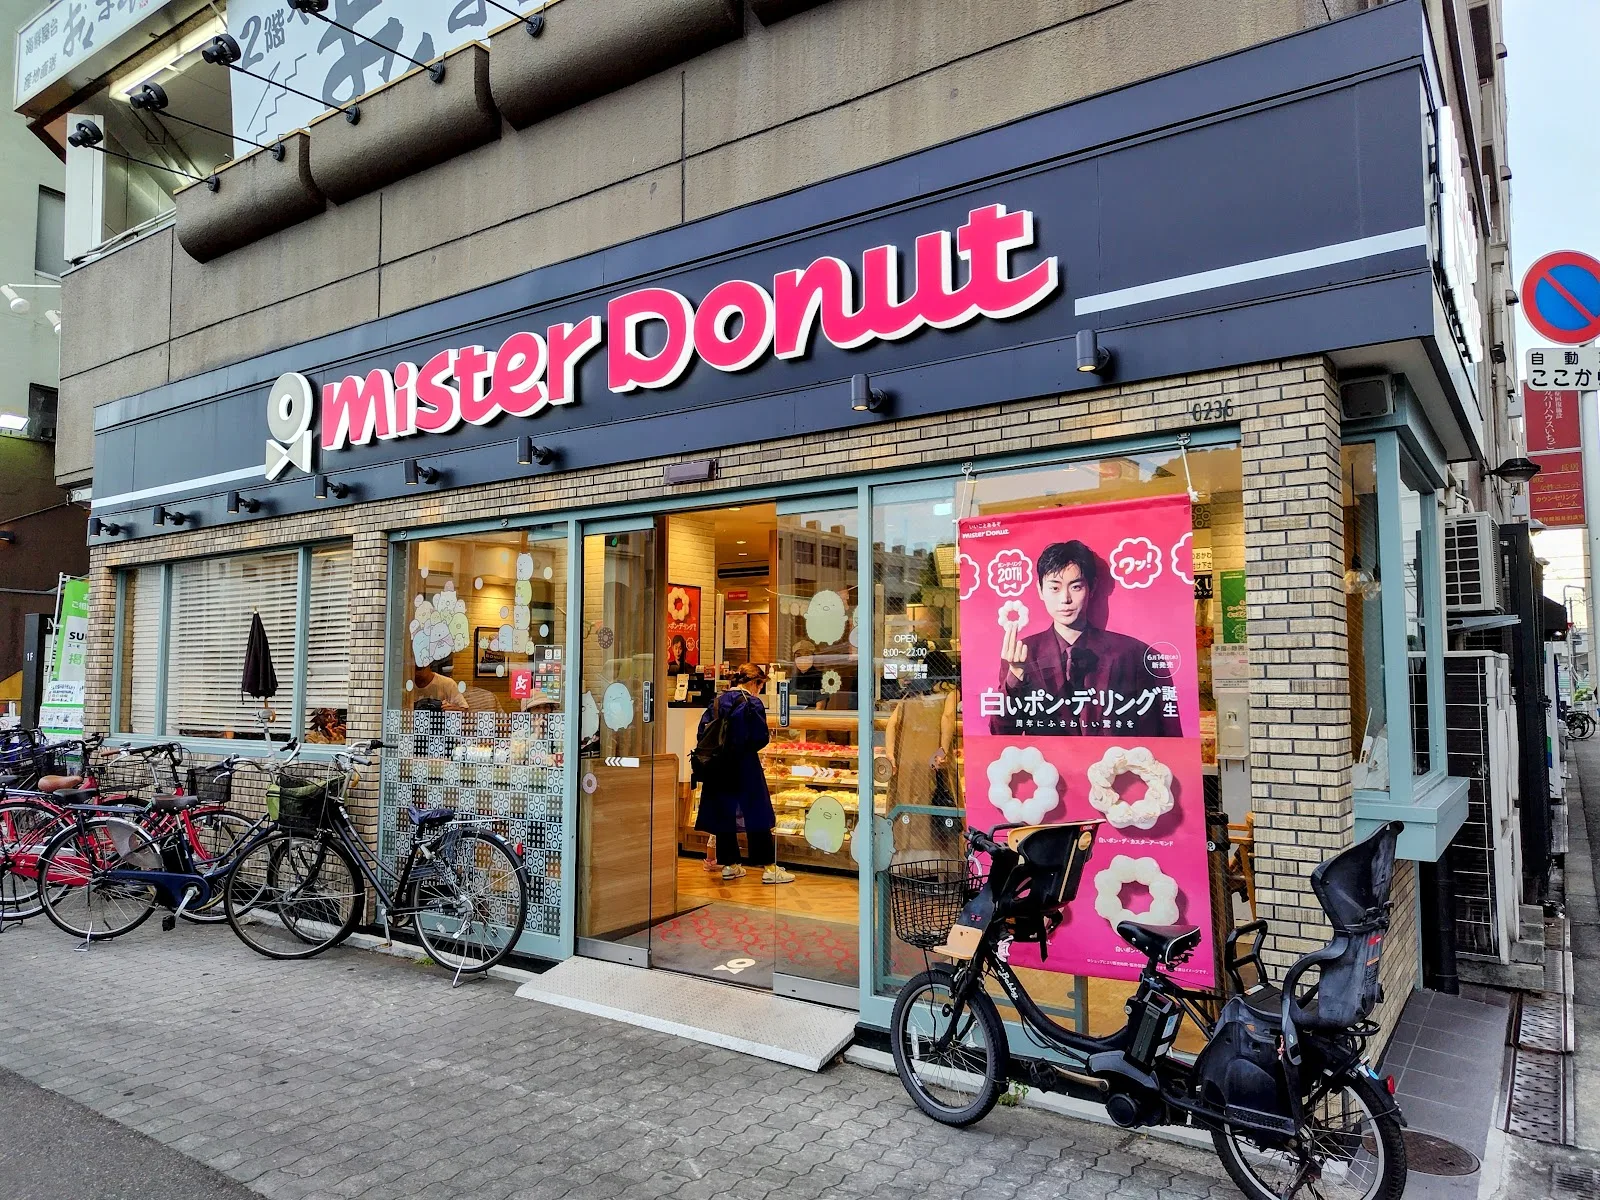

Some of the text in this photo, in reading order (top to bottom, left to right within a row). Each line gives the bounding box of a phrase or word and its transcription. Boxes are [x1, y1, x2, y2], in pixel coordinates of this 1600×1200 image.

[1192, 398, 1234, 421] 0236
[1535, 493, 1578, 503] カウンセリング
[968, 521, 1002, 530] いいことあるぞ
[997, 566, 1023, 584] 20TH
[893, 634, 918, 643] OPEN
[27, 652, 34, 661] 1F
[1151, 661, 1174, 669] 新発売
[1161, 686, 1179, 718] 誕生
